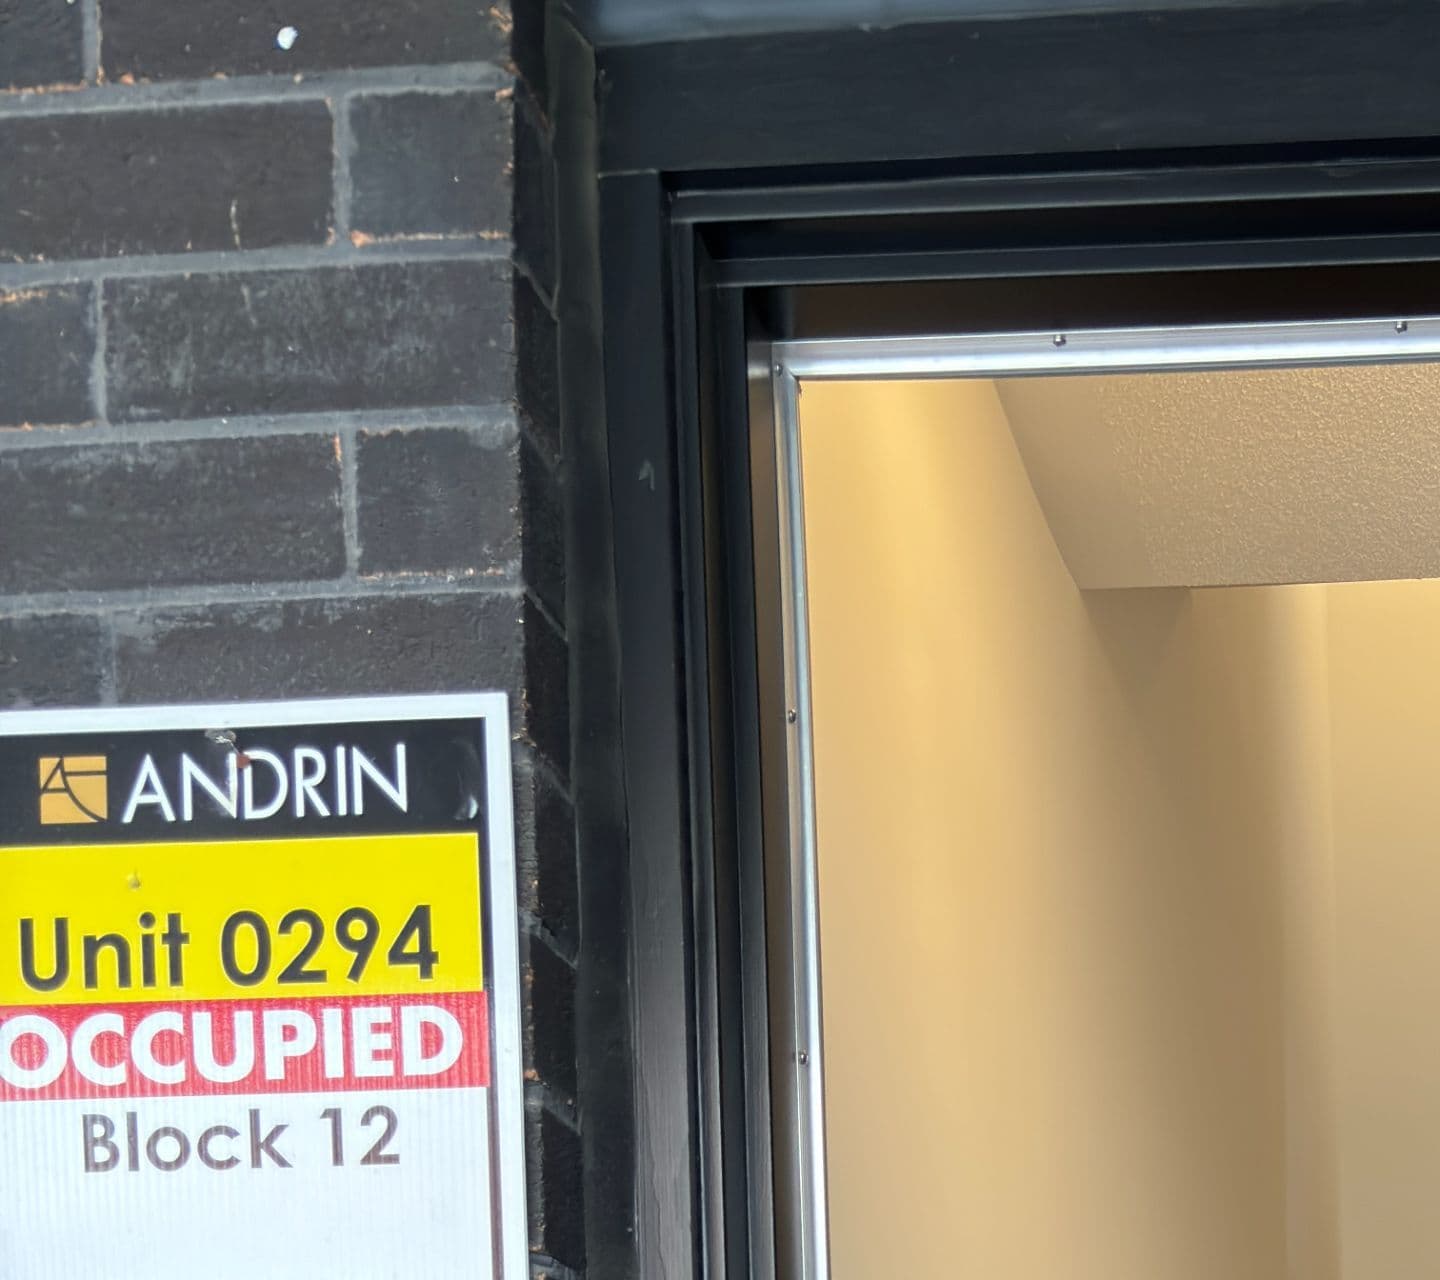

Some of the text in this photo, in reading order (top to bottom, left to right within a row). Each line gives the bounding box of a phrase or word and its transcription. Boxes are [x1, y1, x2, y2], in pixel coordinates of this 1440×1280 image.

[123, 743, 408, 823] ANDRIN
[19, 904, 439, 991] Unit 0294
[0, 1005, 464, 1088] OCCUPIED
[82, 1105, 401, 1173] Block 12
